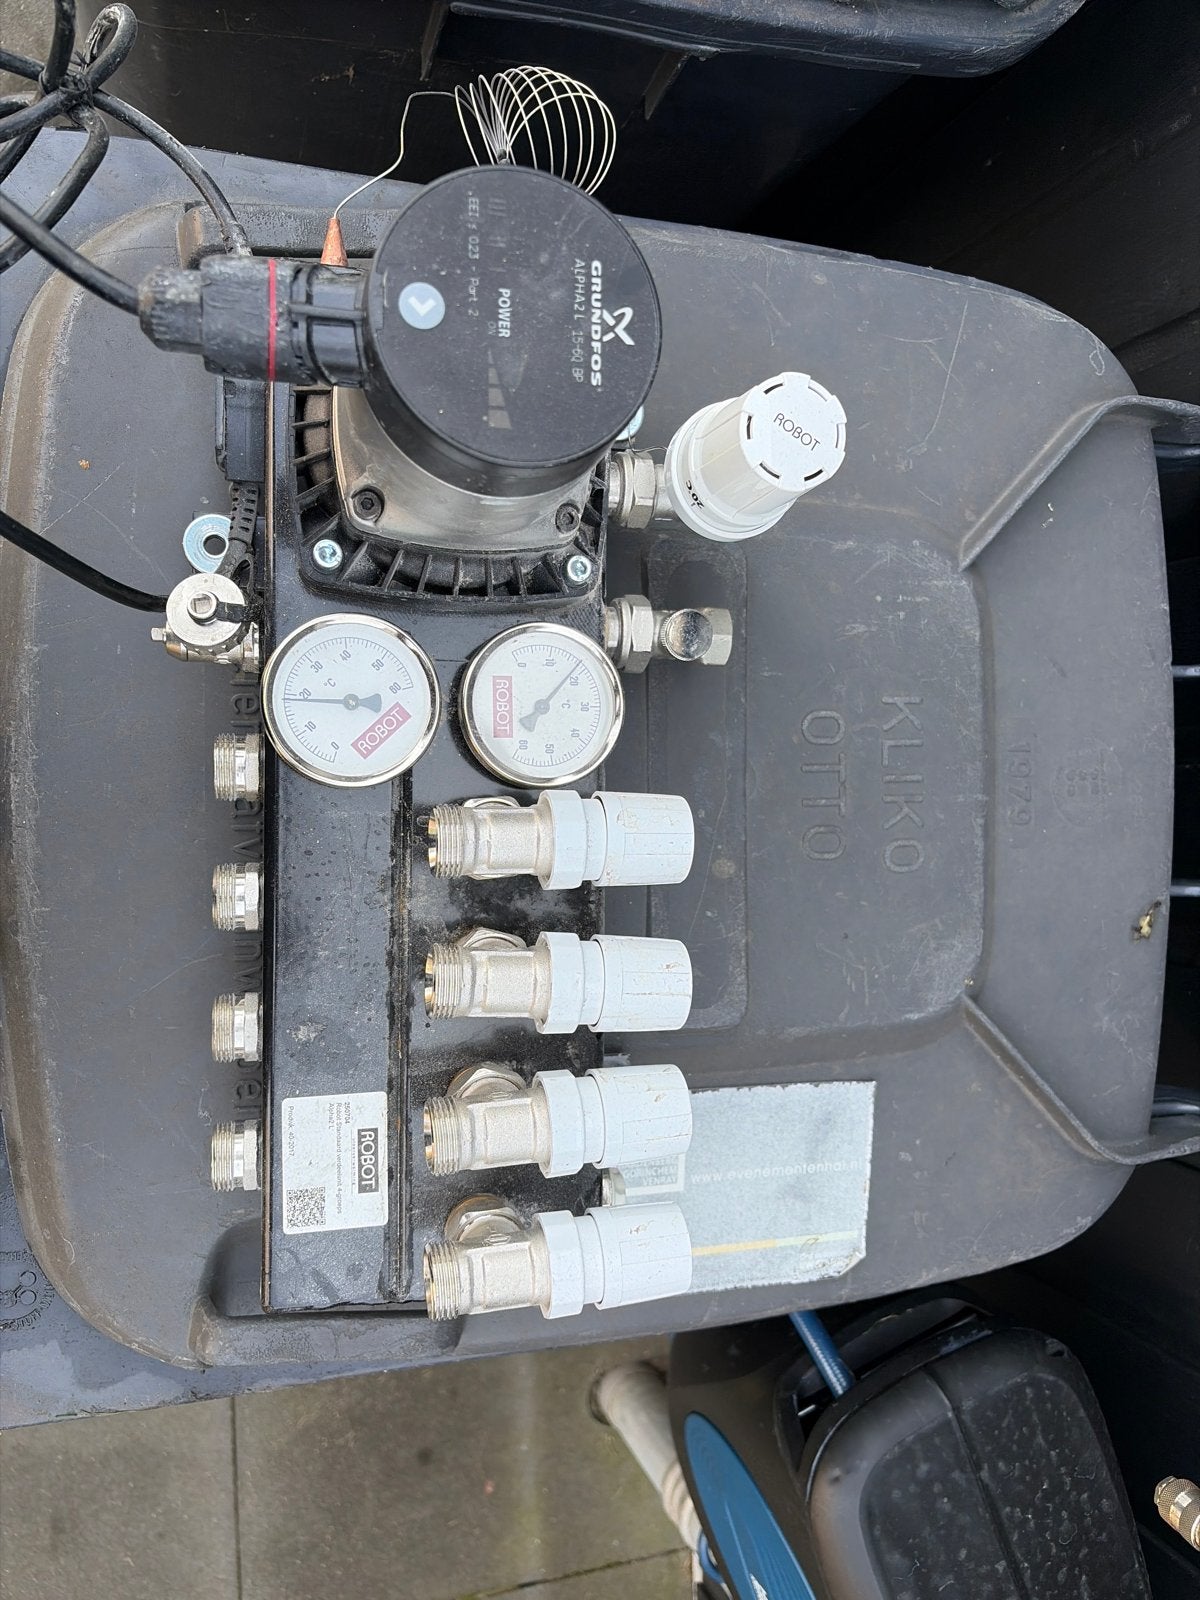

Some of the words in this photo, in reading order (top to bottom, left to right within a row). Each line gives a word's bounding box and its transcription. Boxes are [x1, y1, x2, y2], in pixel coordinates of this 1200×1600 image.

[468, 277, 481, 302] Part
[573, 258, 586, 312] ALPHA2
[468, 308, 480, 317] 2
[497, 287, 511, 338] POWER
[573, 312, 585, 320] L
[590, 260, 602, 387] GRUNDFOS
[772, 412, 821, 451] ROBOT
[339, 649, 352, 662] 40
[310, 660, 323, 674] 30
[371, 659, 384, 671] 50
[545, 658, 557, 667] 10
[323, 678, 337, 688] °C
[388, 682, 401, 694] 60
[570, 676, 579, 687] 20
[299, 688, 312, 700] 20
[495, 679, 510, 737] ROBOT
[580, 701, 590, 712] 30
[304, 720, 317, 732] 10
[356, 706, 405, 755] ROBOT
[570, 728, 580, 738] 40
[330, 741, 339, 751] 0
[518, 739, 529, 750] 60
[544, 743, 555, 754] 50
[800, 709, 847, 861] OTTO
[881, 694, 925, 875] KLIKO
[1007, 741, 1033, 828] 1979
[327, 1102, 335, 1124] Alpha2
[360, 1130, 376, 1190] ROBOT
[335, 1188, 343, 1214] 4-groeps
